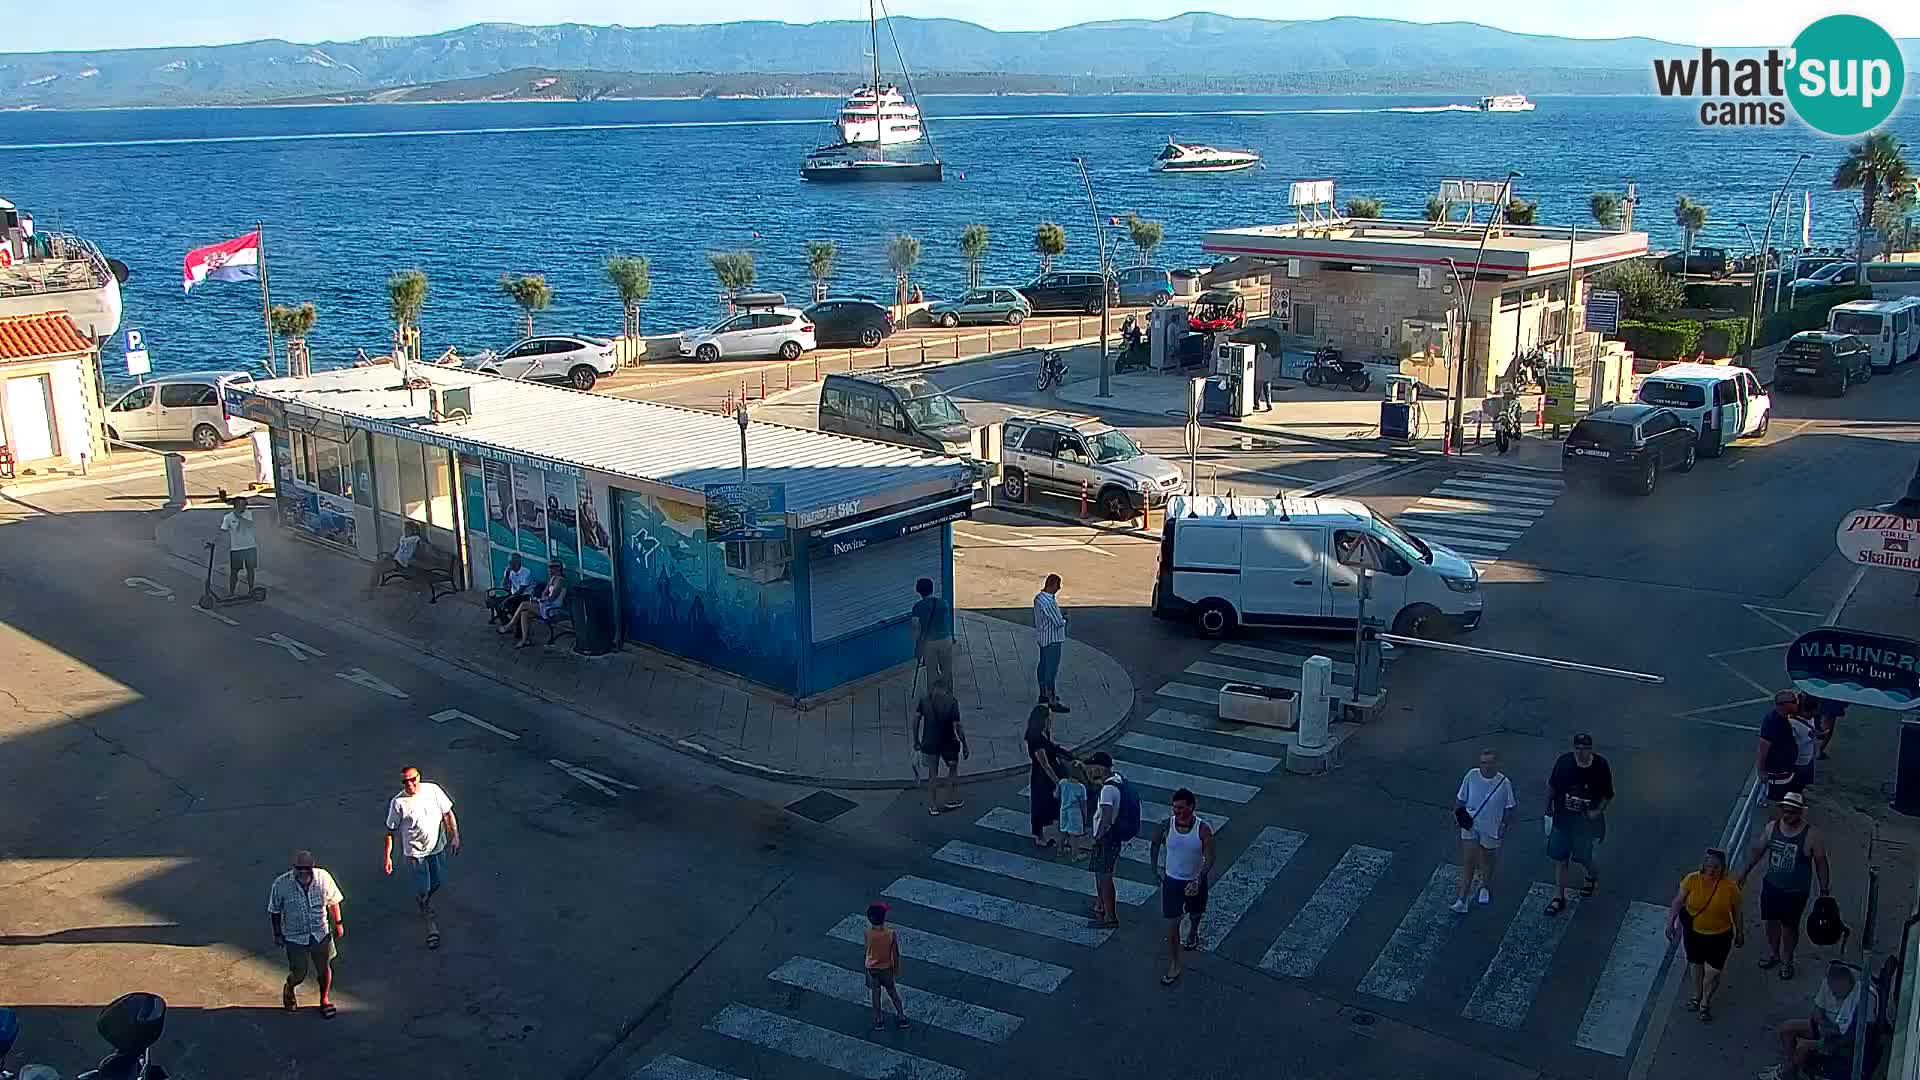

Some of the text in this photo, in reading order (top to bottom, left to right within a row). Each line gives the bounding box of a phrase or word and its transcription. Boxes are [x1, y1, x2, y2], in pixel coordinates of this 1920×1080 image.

[127, 331, 141, 350] P
[477, 446, 492, 457] BUS
[493, 449, 525, 464] STATION
[527, 457, 552, 471] TICKET
[554, 463, 581, 477] OFFICE
[1828, 663, 1897, 680] caffe bar
